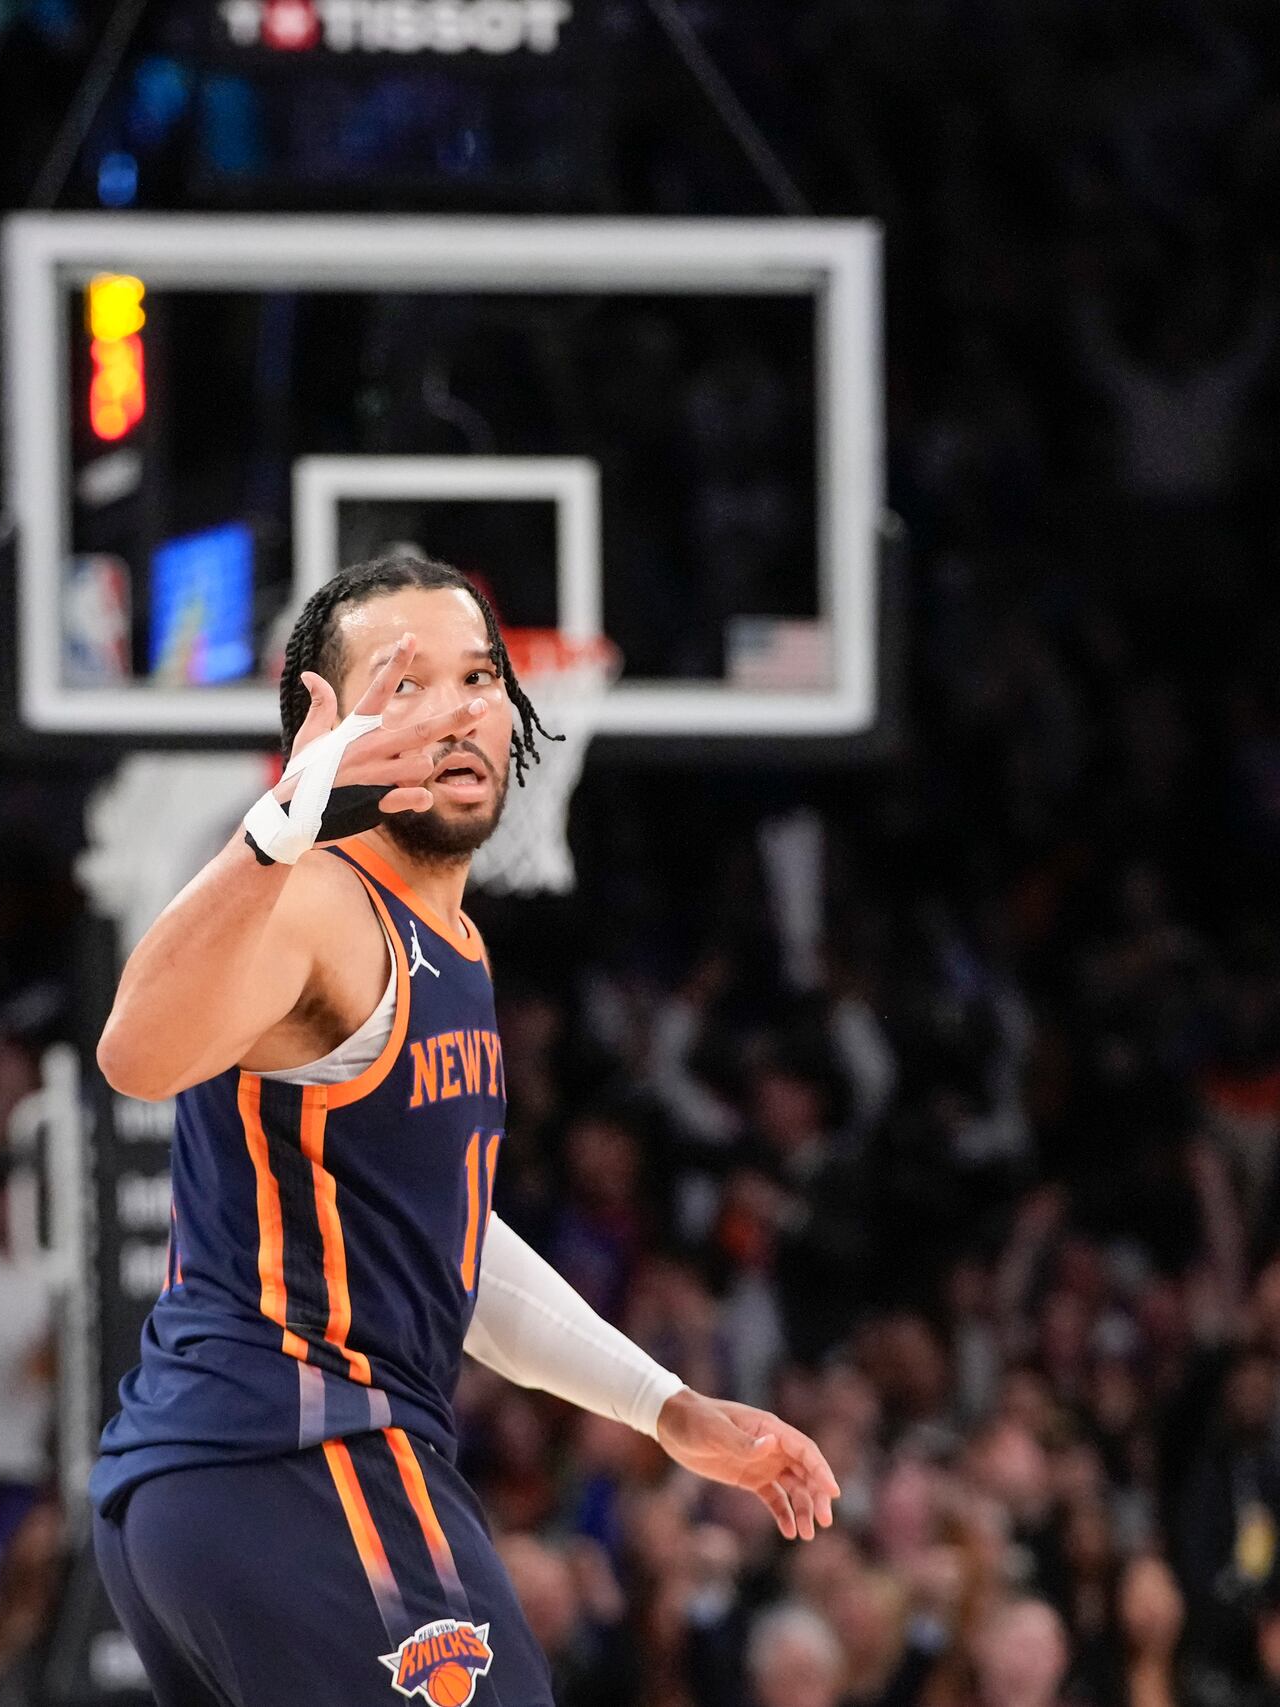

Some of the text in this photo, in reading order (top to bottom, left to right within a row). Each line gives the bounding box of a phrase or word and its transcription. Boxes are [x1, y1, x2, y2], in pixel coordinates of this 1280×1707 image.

[321, 0, 572, 54] TISSOT
[397, 1626, 490, 1690] KNICKS
[418, 1623, 457, 1641] NEW YORK
